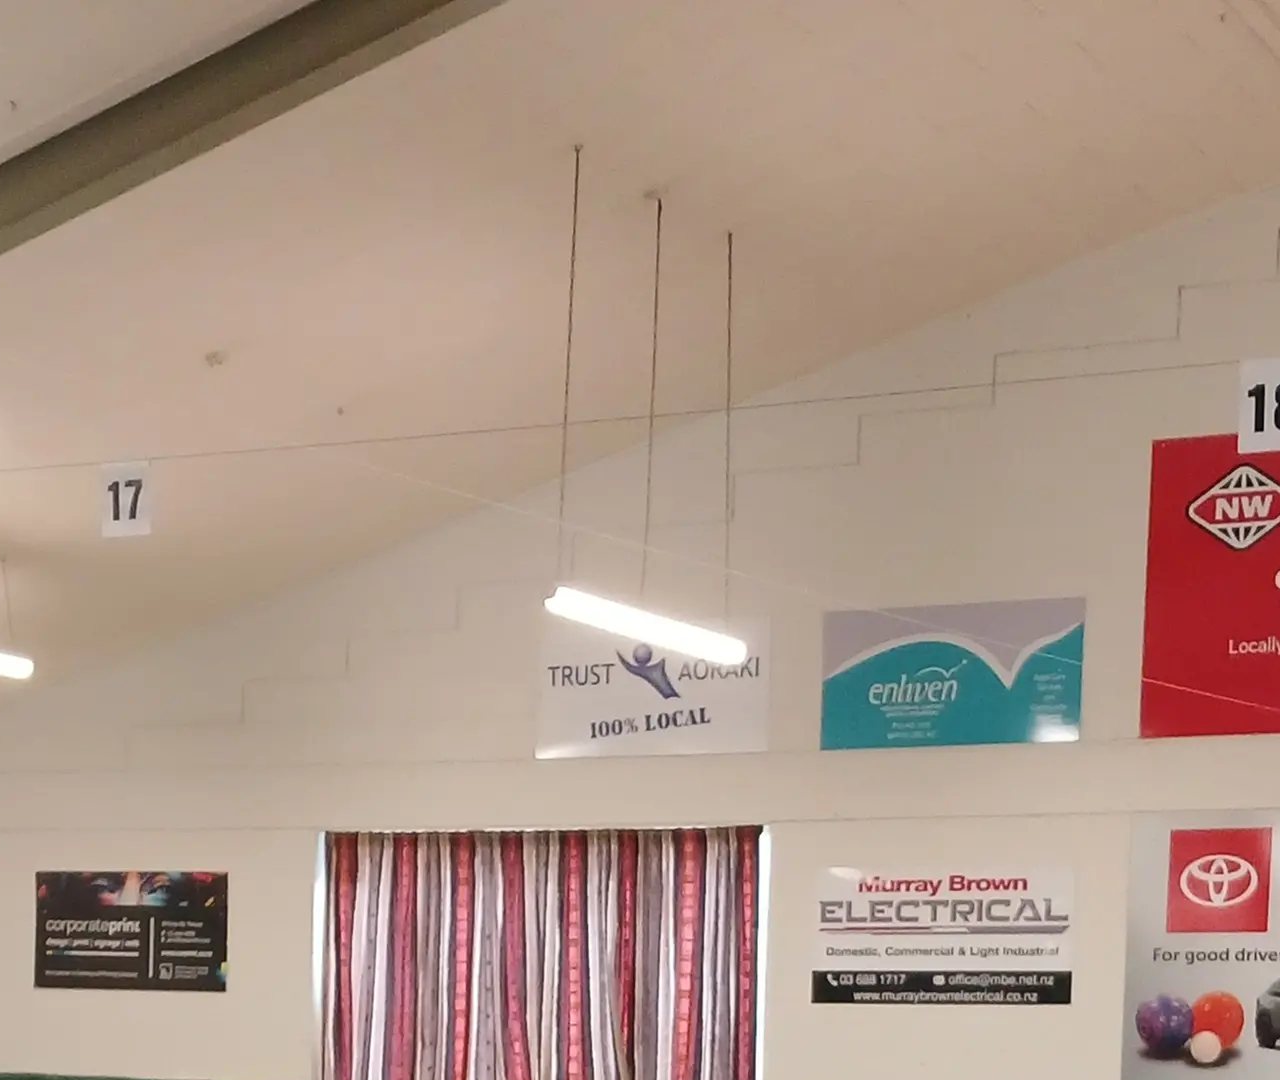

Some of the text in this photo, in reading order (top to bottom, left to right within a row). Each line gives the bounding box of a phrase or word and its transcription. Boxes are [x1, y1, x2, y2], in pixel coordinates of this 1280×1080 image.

[107, 478, 143, 521] 17
[1214, 494, 1274, 521] NW
[547, 663, 615, 687] TRUST
[869, 674, 959, 705] enliven
[590, 706, 711, 739] 100% LOCAL
[858, 874, 1029, 896] Murray Brown
[819, 898, 1069, 924] ELECTRICAL
[825, 946, 1060, 958] Domestic, Commercial & Light Industrial
[1152, 948, 1181, 962] For
[1185, 947, 1230, 965] good
[879, 974, 907, 985] 1717
[853, 990, 1038, 1004] www.murraybrownelectrical.co.nz
